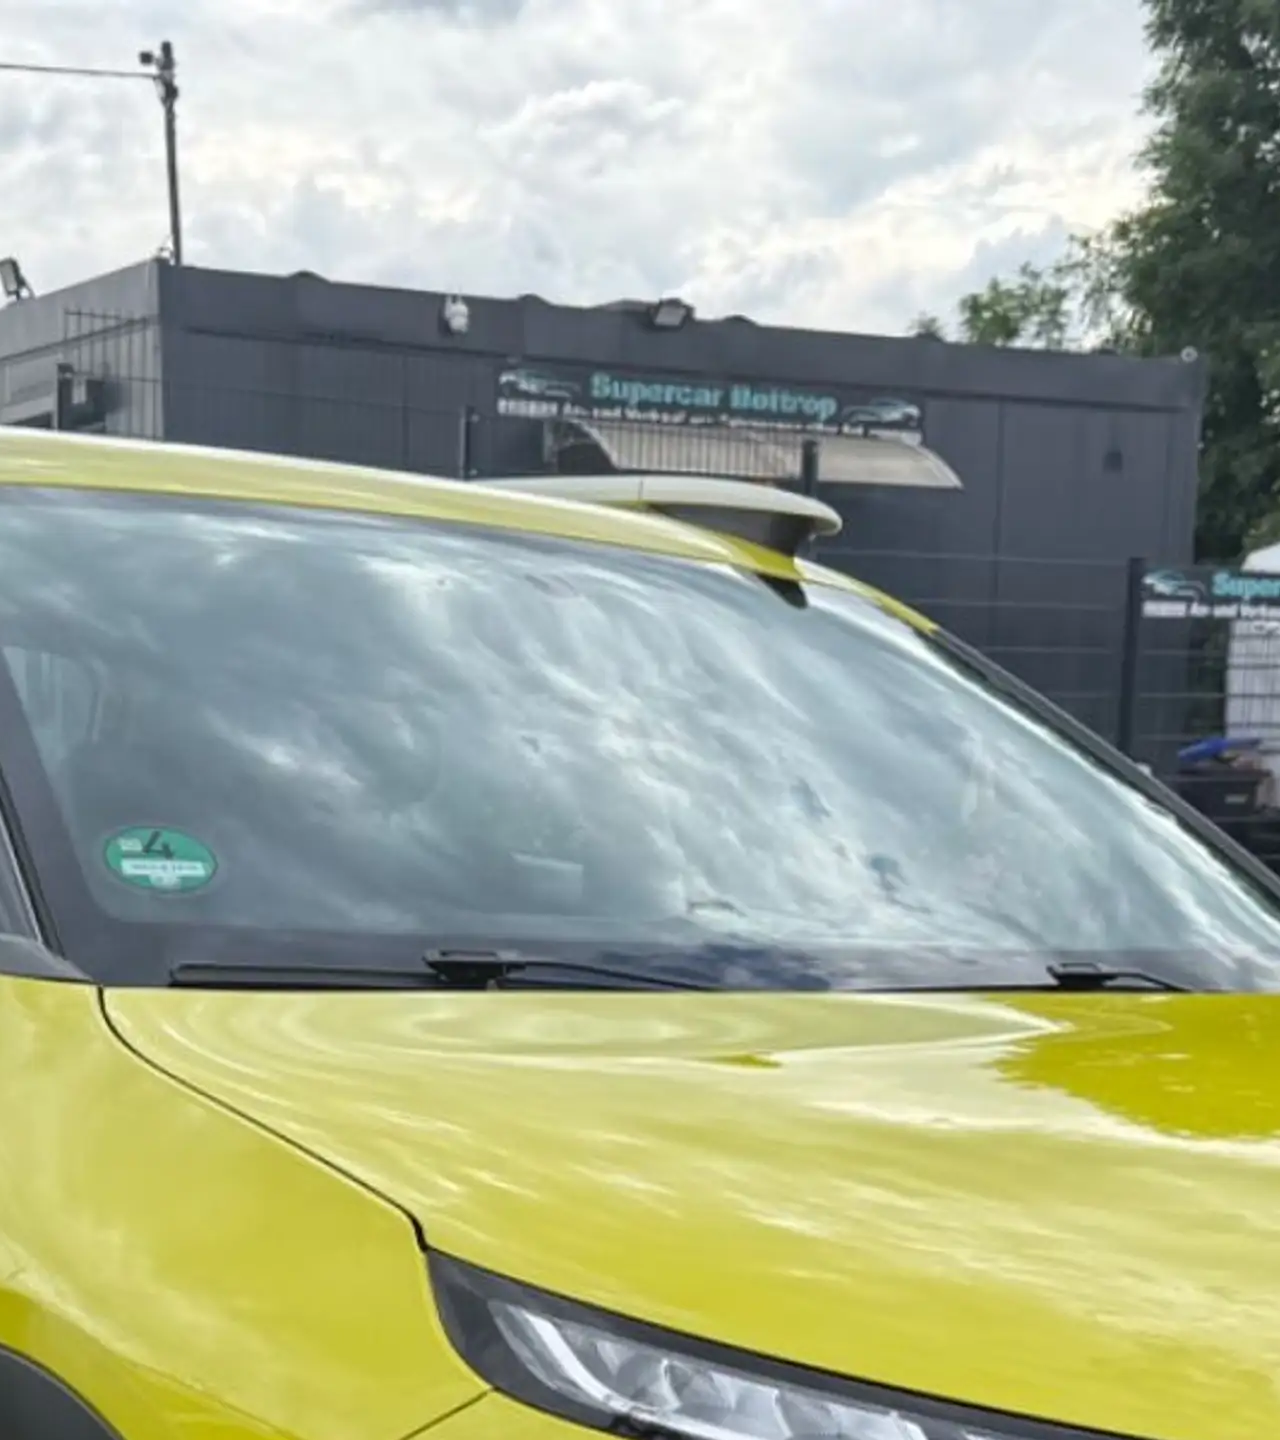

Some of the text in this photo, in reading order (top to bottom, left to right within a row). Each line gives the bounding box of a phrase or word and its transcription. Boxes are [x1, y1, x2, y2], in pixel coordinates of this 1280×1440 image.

[590, 372, 722, 410] Supercar
[730, 383, 838, 422] Bottrop
[141, 829, 174, 861] 4
